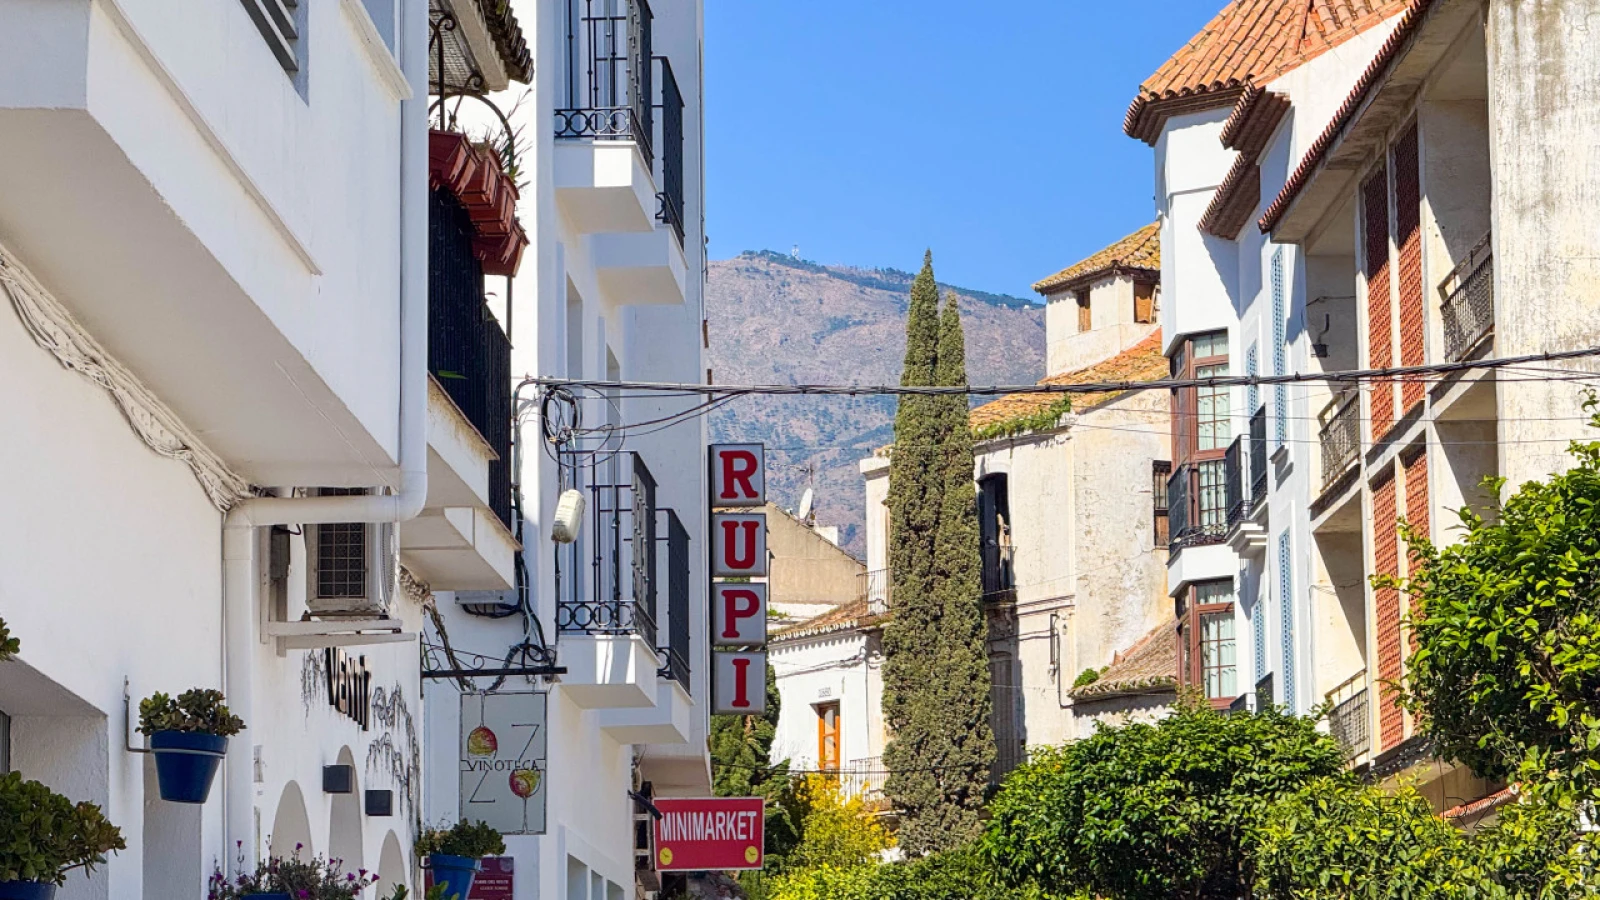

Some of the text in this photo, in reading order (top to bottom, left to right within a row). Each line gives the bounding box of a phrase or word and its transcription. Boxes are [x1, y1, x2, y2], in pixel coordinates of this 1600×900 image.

[719, 450, 760, 708] RUPI
[466, 759, 540, 772] VINOTECA
[660, 810, 758, 842] MINIMARKET
